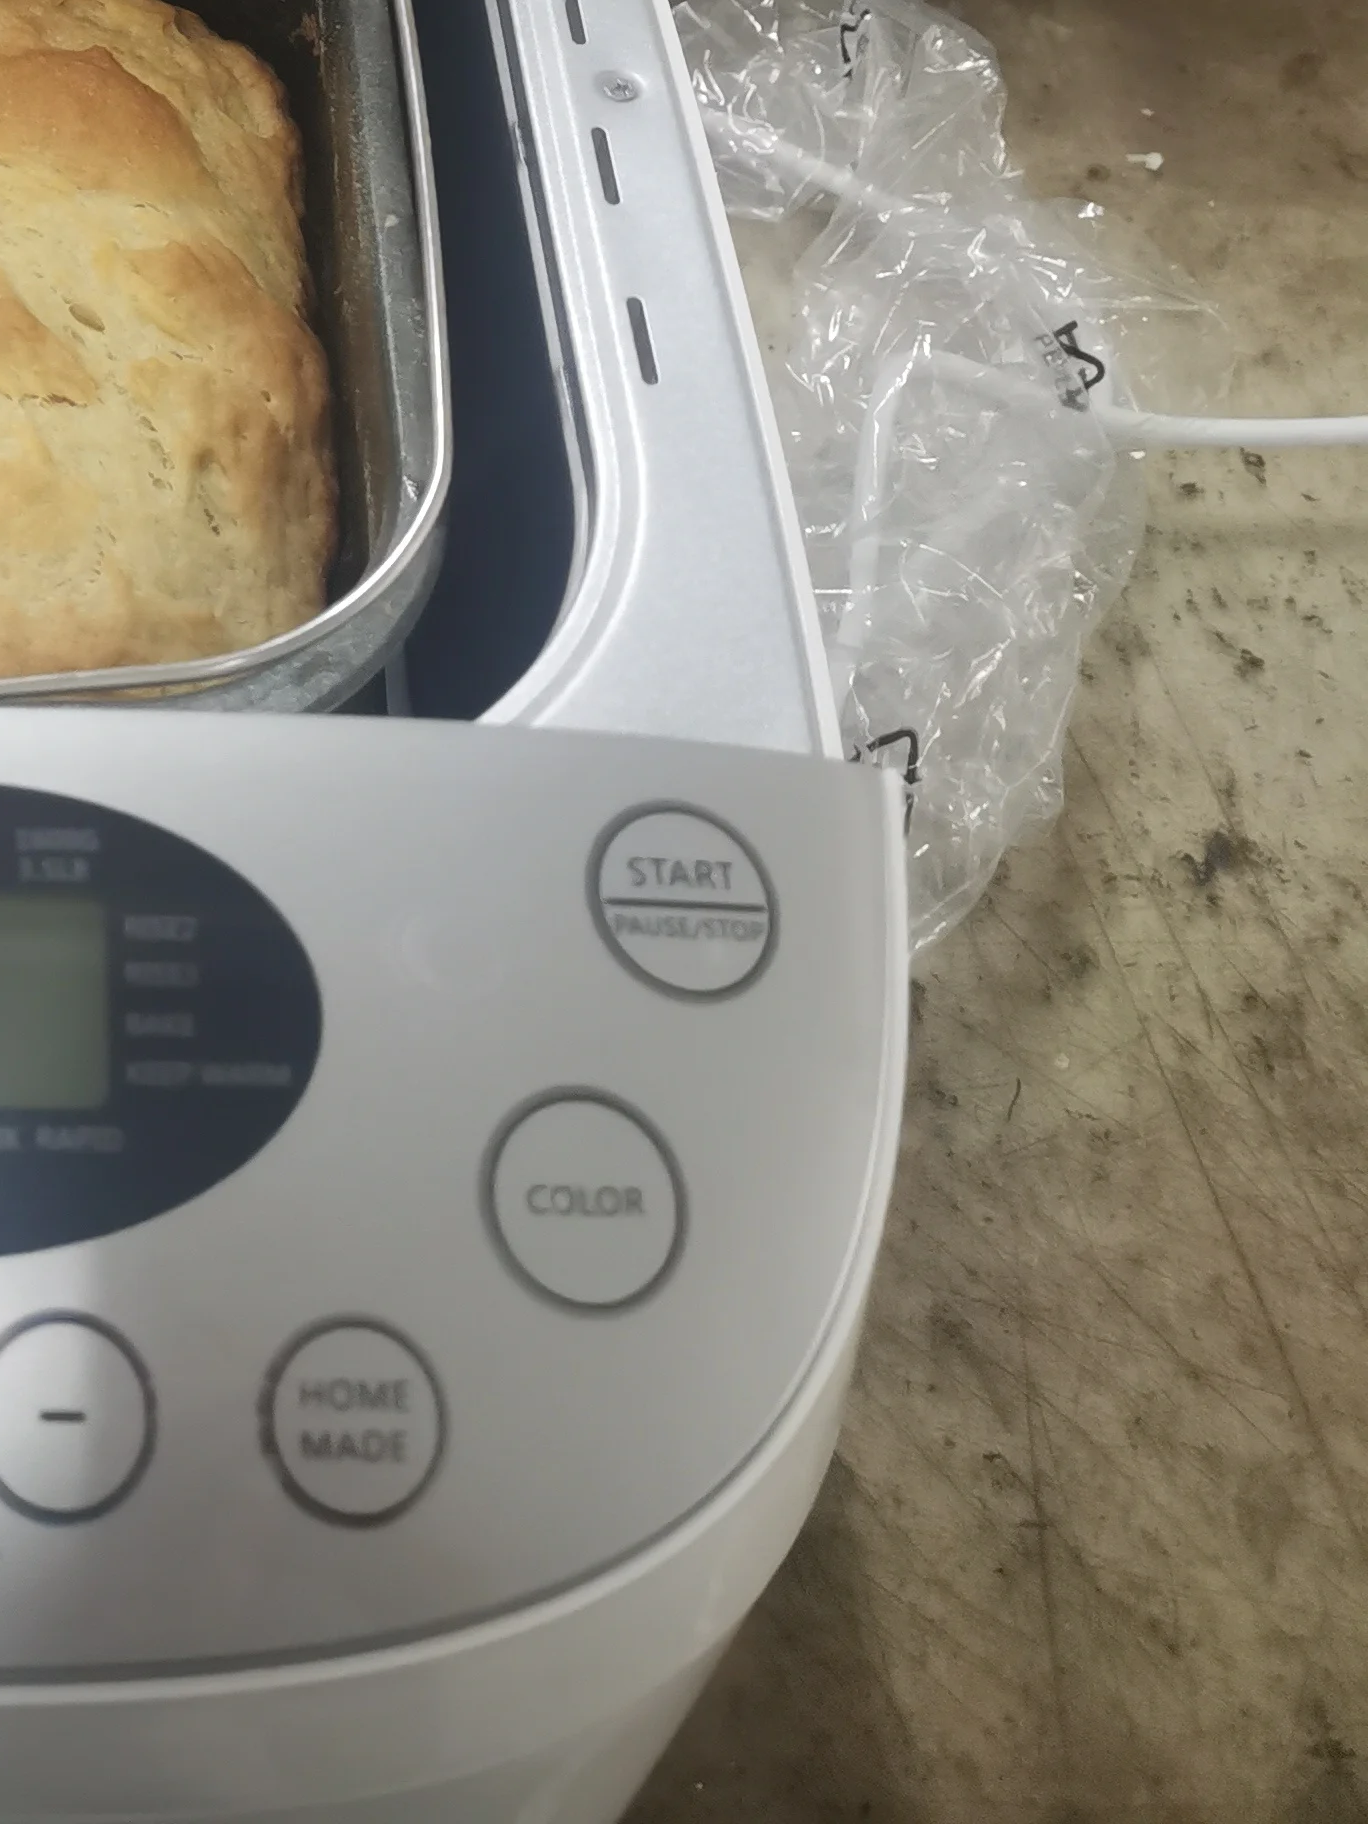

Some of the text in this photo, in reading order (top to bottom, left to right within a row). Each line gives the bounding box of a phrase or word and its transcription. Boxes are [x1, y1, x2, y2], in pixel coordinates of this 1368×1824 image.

[627, 857, 733, 890] START
[612, 913, 765, 942] PAUSE/STOP
[526, 1184, 645, 1216] COLOR
[298, 1379, 410, 1413] HOME
[299, 1429, 408, 1464] MADE
